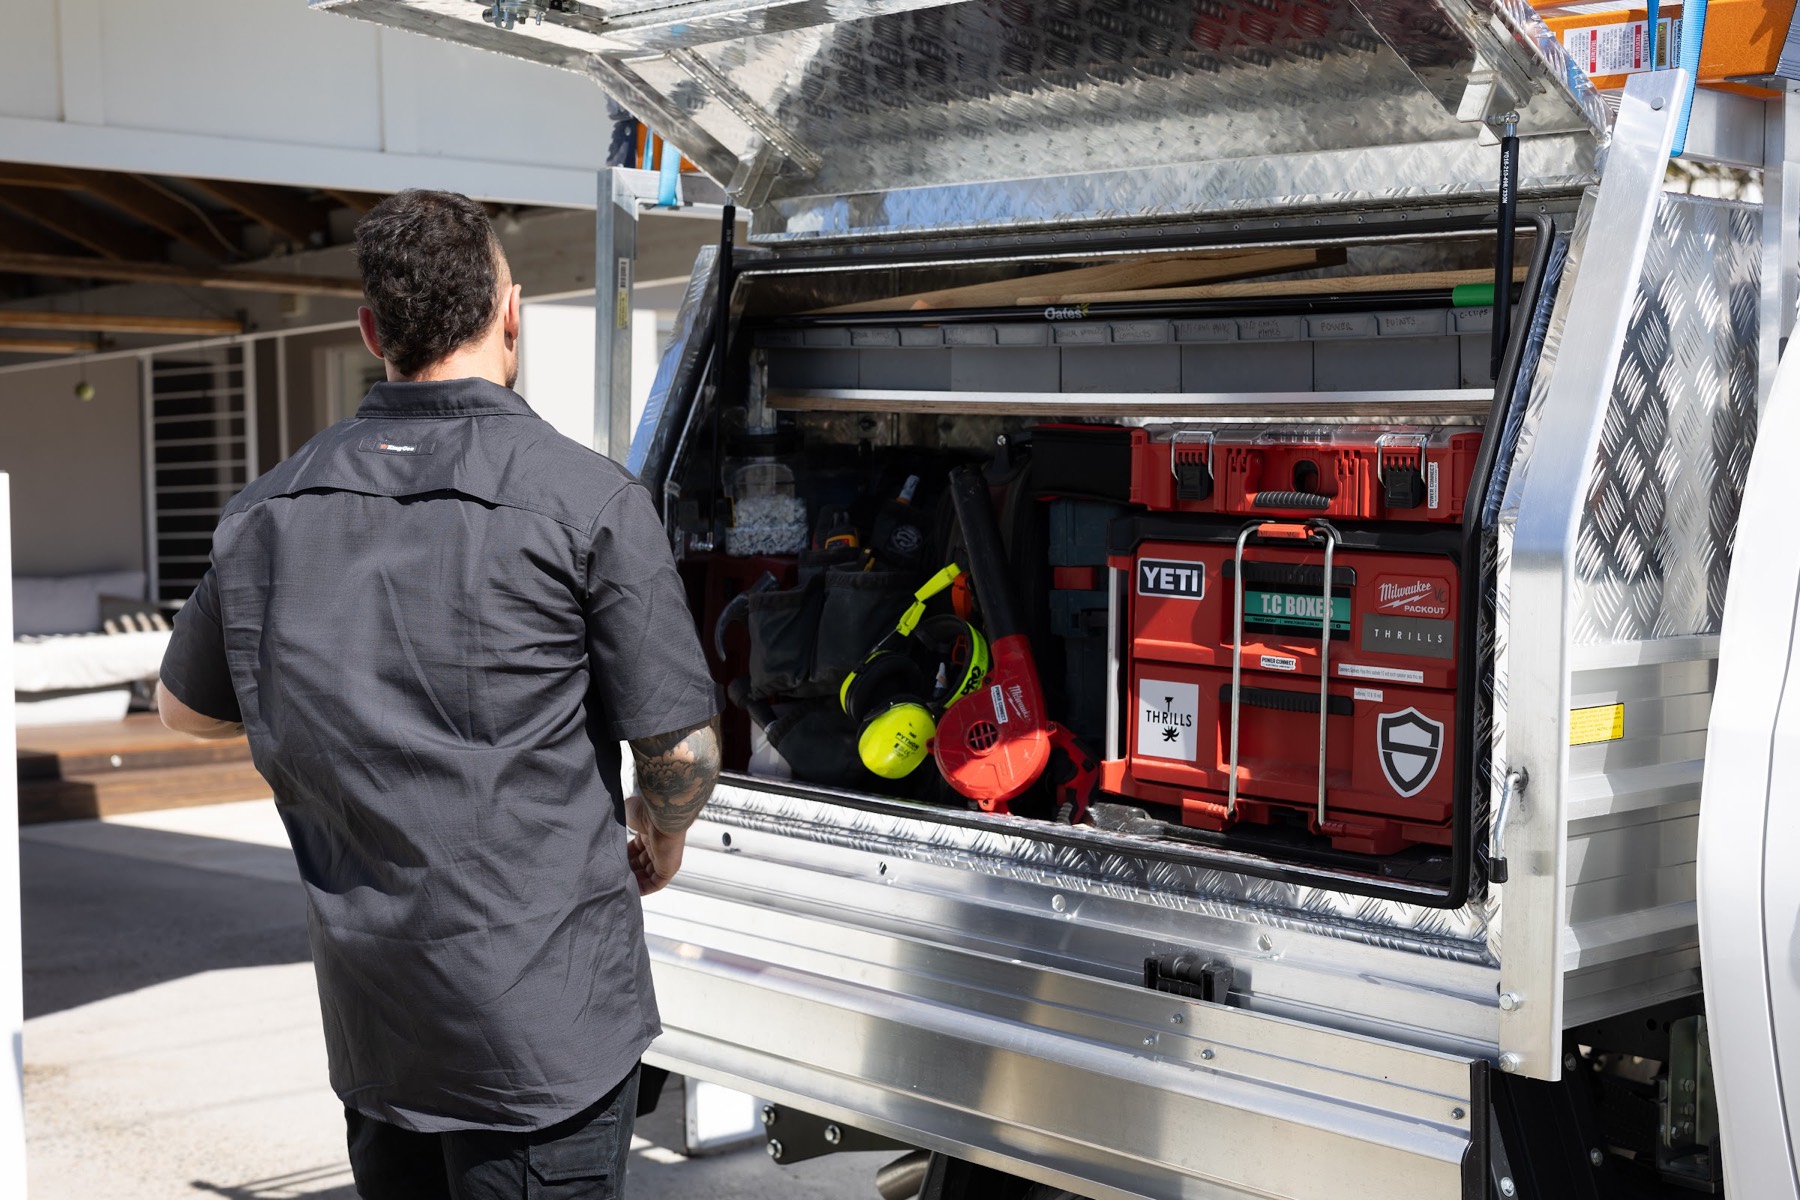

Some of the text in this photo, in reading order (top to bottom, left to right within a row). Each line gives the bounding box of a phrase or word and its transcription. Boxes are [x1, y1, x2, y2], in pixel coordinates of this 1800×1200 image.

[1658, 52, 1666, 64] CARE
[1044, 307, 1082, 320] Oates
[1142, 566, 1199, 592] YETI
[1378, 580, 1433, 602] Milwaukee
[1261, 594, 1282, 614] T.C
[1404, 605, 1446, 615] PACKOUT
[1374, 629, 1443, 644] THRILLS
[1261, 657, 1276, 665] POWER
[1276, 658, 1294, 667] CONNECT
[960, 665, 981, 696] PRO
[998, 701, 1007, 721] CONNECT
[1146, 710, 1193, 728] THRILLS
[896, 732, 920, 751] PYTHON
